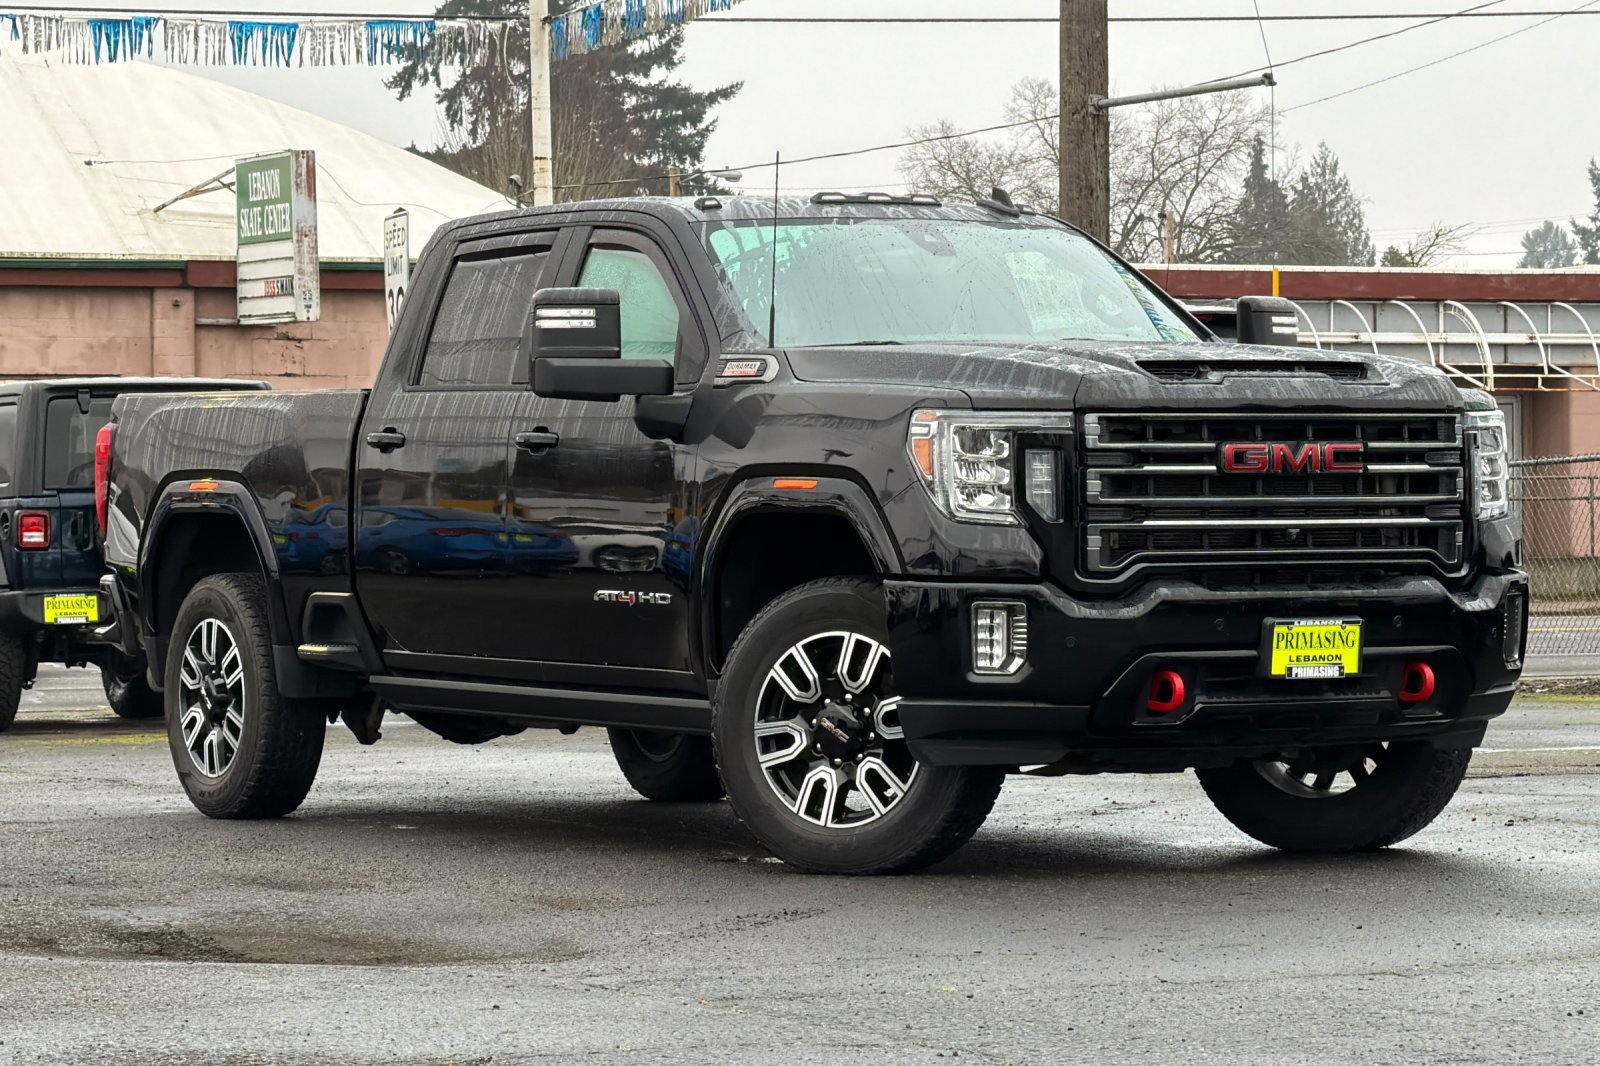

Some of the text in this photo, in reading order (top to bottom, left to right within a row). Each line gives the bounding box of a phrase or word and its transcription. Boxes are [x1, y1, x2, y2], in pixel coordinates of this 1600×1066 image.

[248, 169, 280, 202] LEBANON
[240, 203, 291, 238] SKATE CENTER
[385, 227, 406, 251] SPEED
[387, 255, 403, 277] LIMIT
[727, 362, 758, 370] DURAMAX
[1224, 443, 1364, 473] GMC
[46, 599, 95, 610] PRIMASING
[1275, 631, 1356, 649] PRIMASING
[1288, 654, 1342, 663] LEBANON
[1291, 667, 1339, 678] PRIMASING
